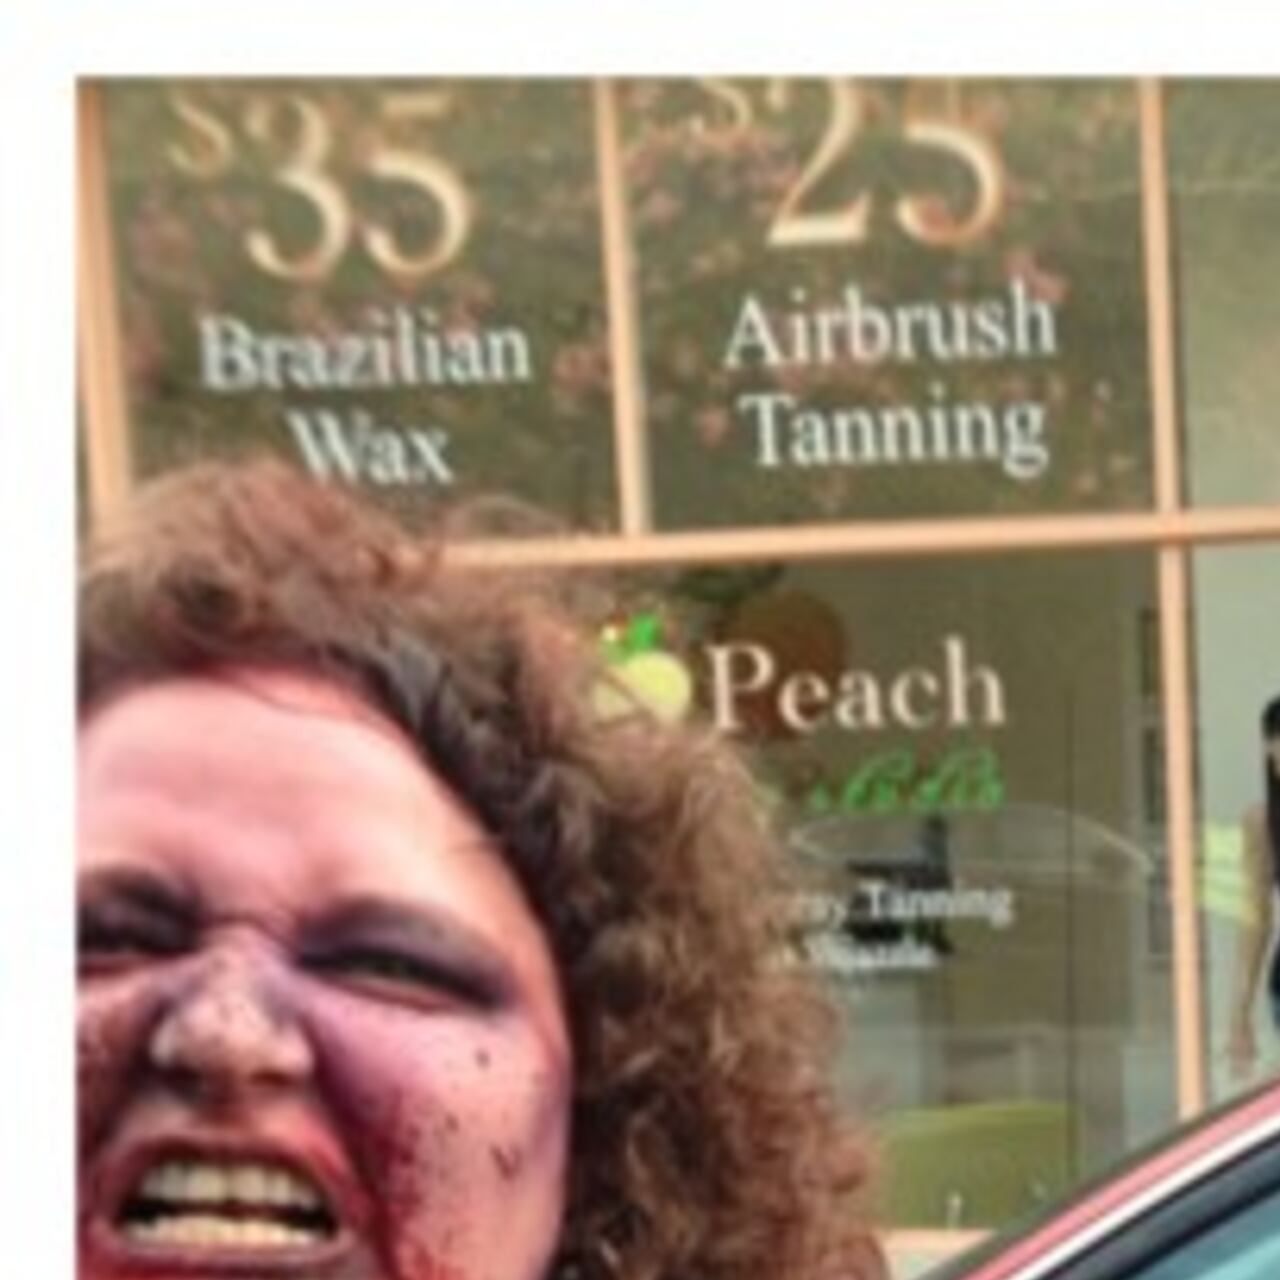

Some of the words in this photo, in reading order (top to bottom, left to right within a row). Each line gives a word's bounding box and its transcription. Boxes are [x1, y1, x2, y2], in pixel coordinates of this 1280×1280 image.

[202, 316, 532, 394] Brazilian
[724, 284, 1057, 370] Airbrush
[290, 414, 455, 486] Wax
[740, 394, 1049, 475] Tanning
[706, 636, 1006, 732] Peach
